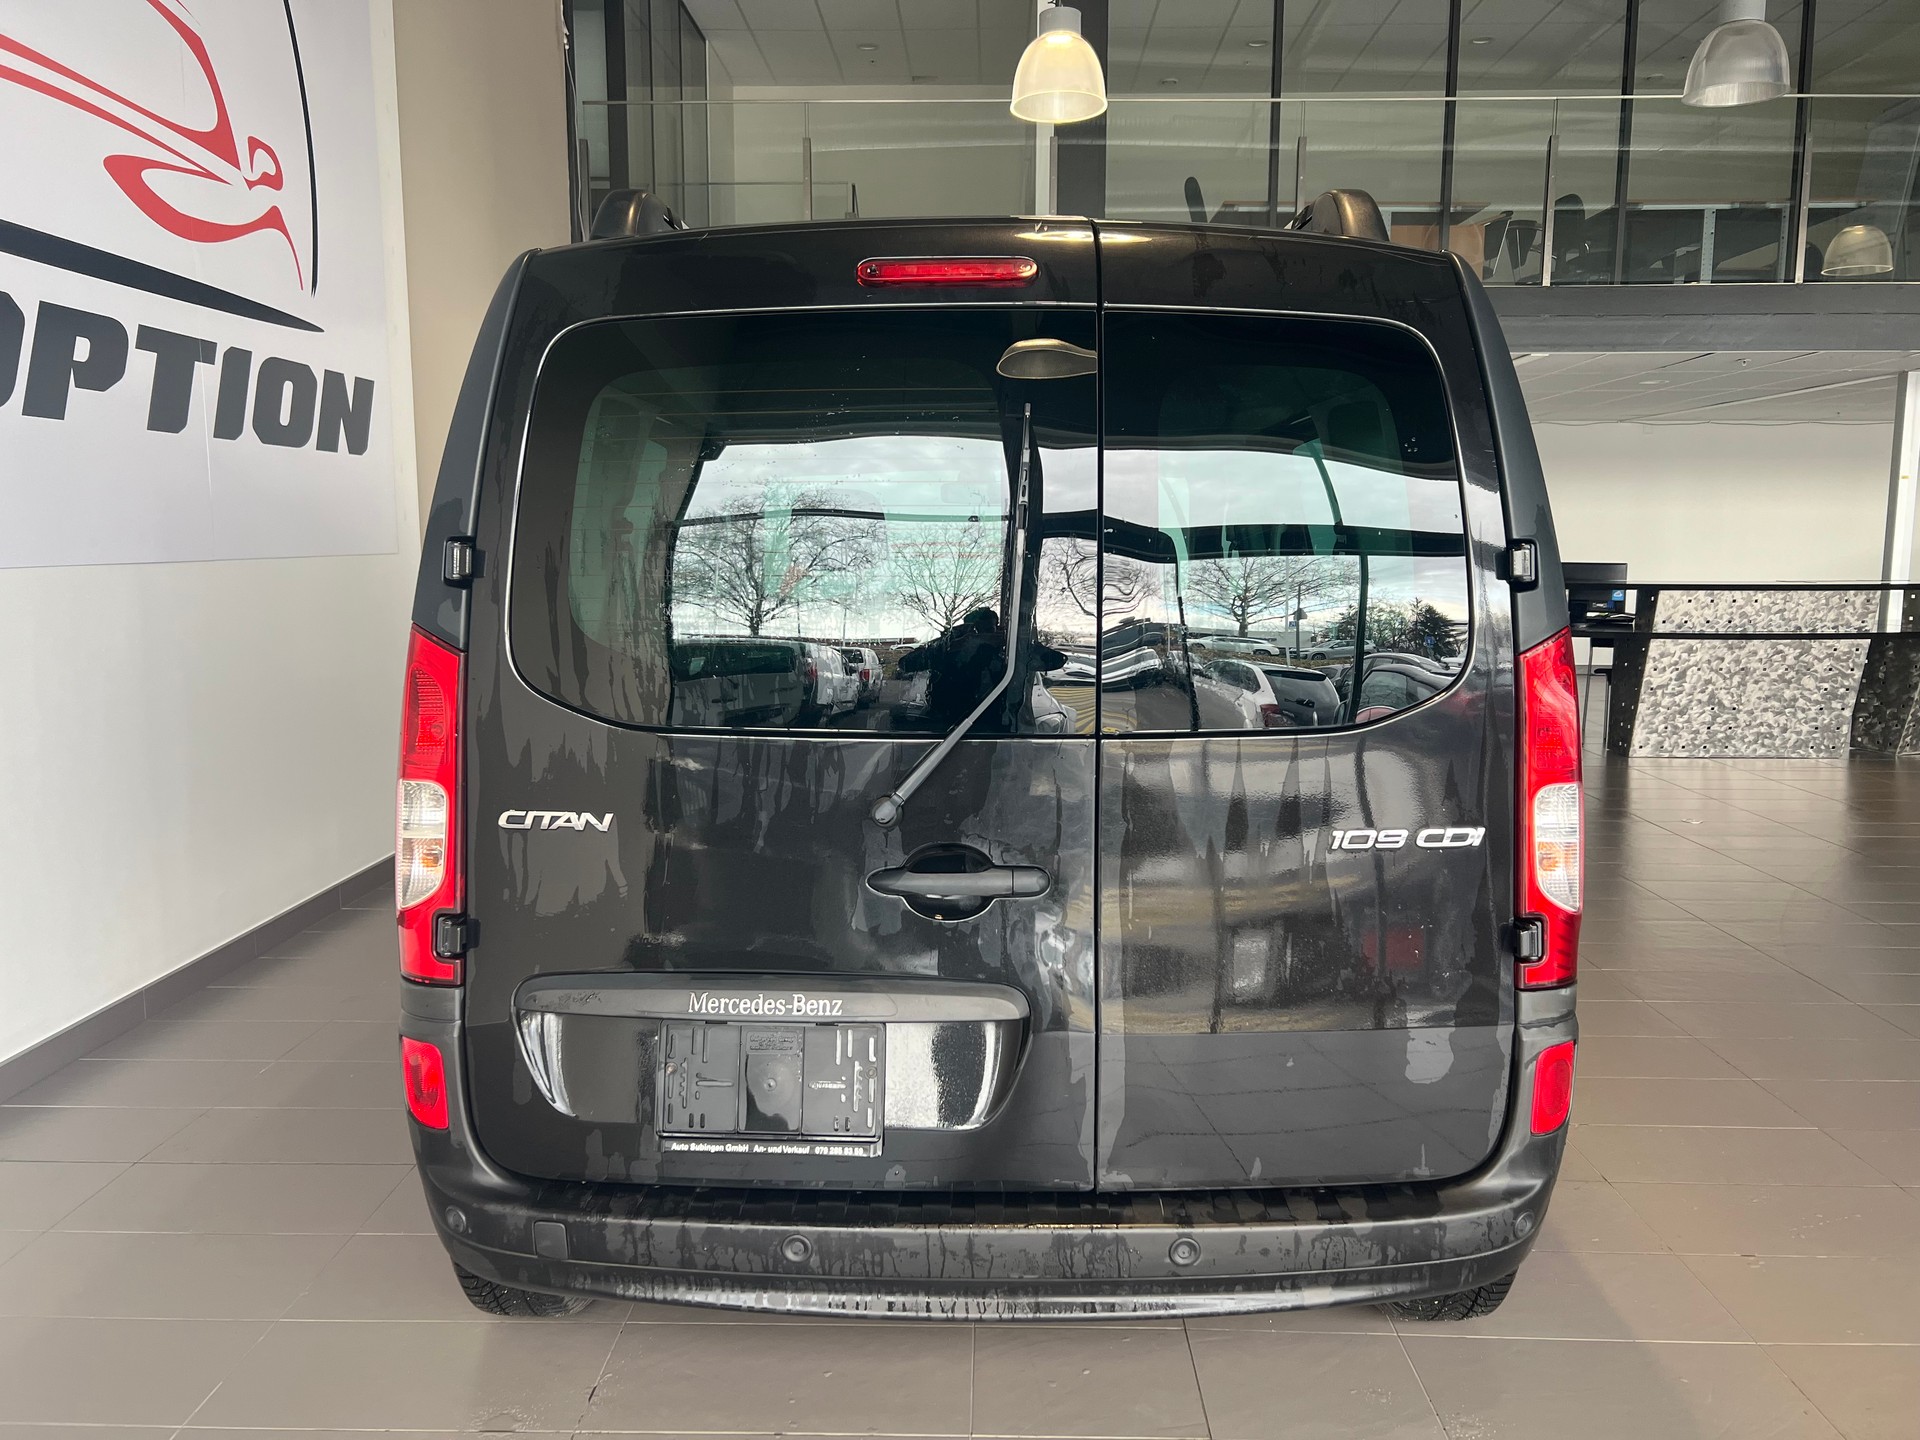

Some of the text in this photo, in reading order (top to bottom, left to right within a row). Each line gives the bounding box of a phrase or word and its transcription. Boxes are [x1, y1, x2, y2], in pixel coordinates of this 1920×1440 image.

[0, 290, 375, 456] PTION
[498, 809, 615, 832] CITAN
[1330, 827, 1486, 850] 109 CDI
[687, 991, 843, 1016] Mercedes-Benz
[671, 1142, 689, 1151] Auto
[725, 1143, 749, 1153] GmbH
[767, 1145, 782, 1154] und
[782, 1145, 811, 1154] Verkauf
